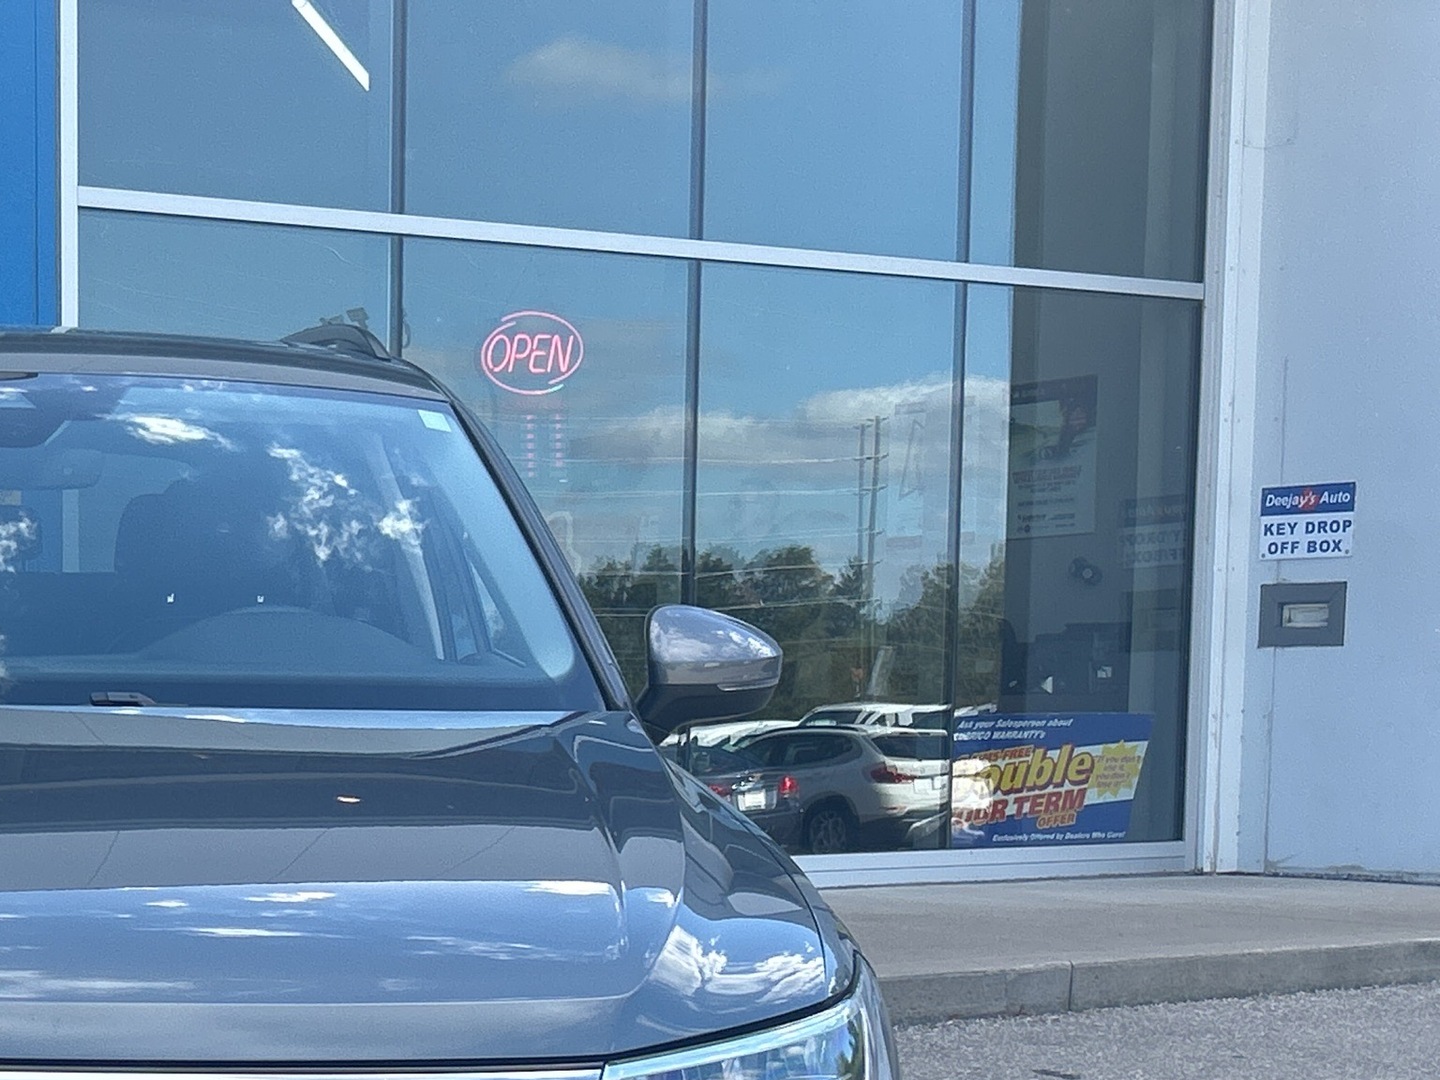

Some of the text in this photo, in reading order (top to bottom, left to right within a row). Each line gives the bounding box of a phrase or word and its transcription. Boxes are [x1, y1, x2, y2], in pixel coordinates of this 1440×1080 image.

[486, 333, 574, 373] OPEN
[1265, 490, 1350, 509] Deejay's Auto
[1263, 519, 1353, 537] KEY DROP
[1268, 539, 1343, 555] OFF BOX
[968, 744, 1095, 793] ouble
[1014, 788, 1088, 818] TERM
[1037, 812, 1077, 828] OFFER
